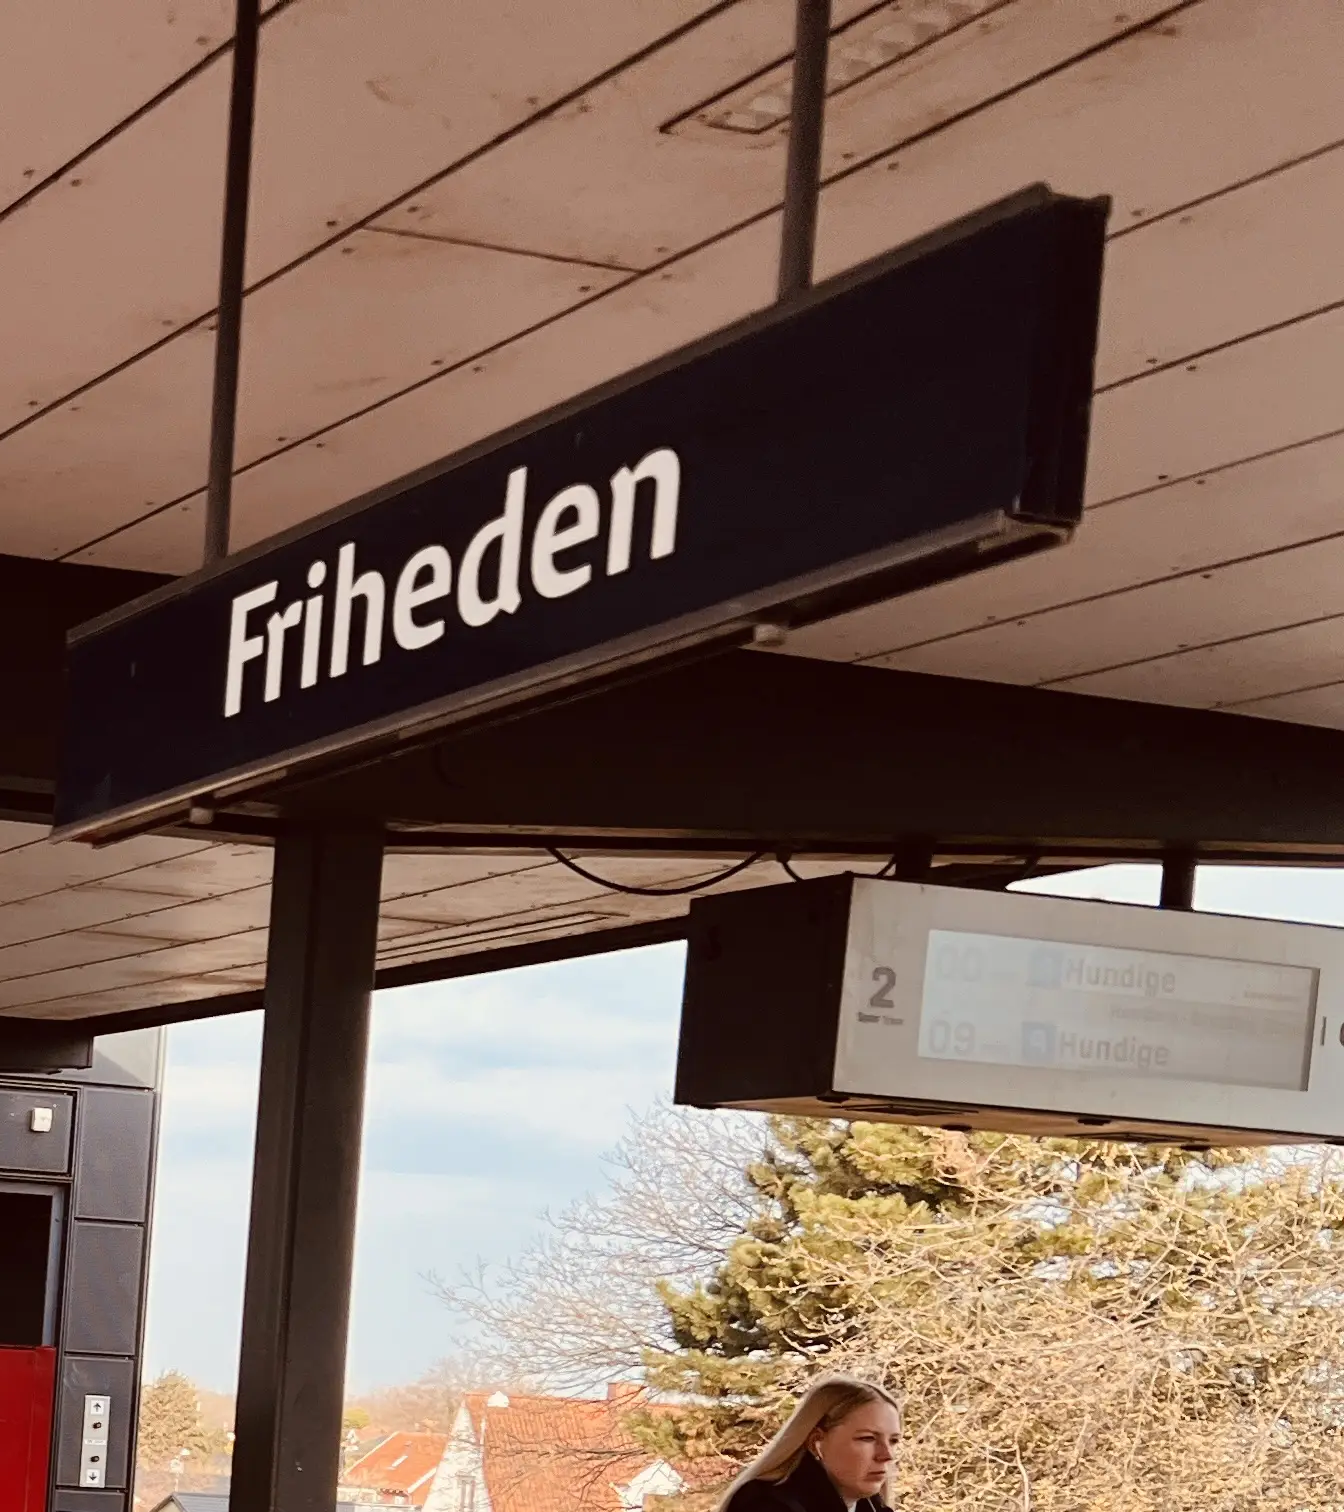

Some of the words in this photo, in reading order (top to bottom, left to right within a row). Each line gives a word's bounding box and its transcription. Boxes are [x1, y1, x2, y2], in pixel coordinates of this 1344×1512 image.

[224, 446, 680, 718] Friheden
[868, 965, 898, 1010] 2
[1065, 956, 1178, 998] Hundige
[1059, 1029, 1171, 1070] Hundige
